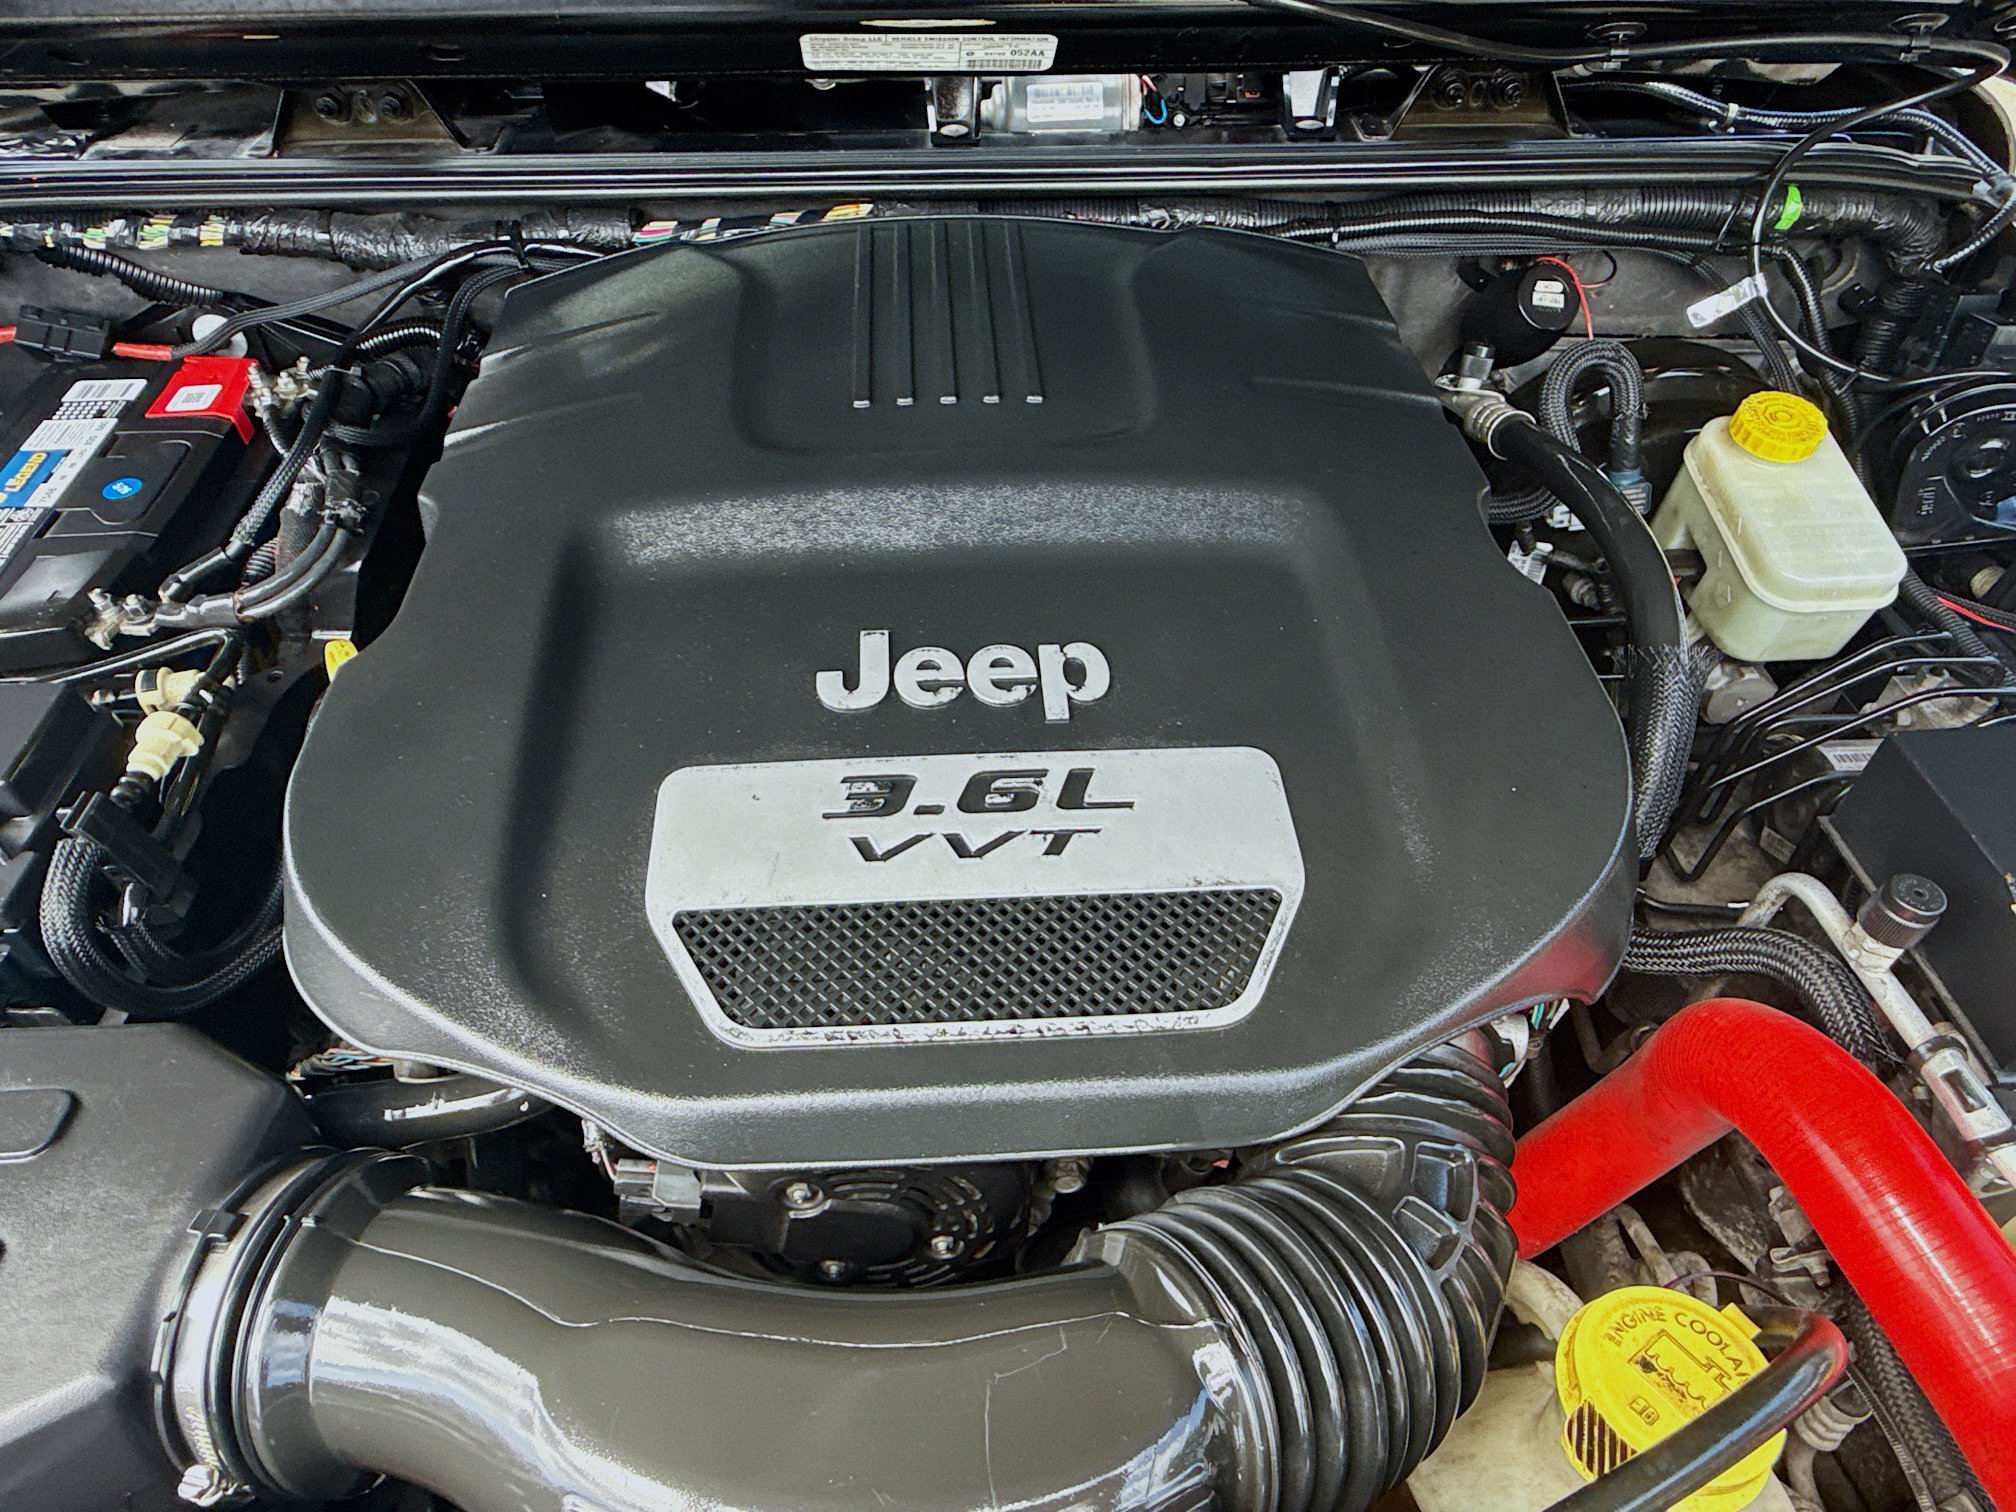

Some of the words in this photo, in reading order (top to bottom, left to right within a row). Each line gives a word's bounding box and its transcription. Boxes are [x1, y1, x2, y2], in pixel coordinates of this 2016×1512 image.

[1010, 49, 1046, 57] 052AA
[815, 629, 1111, 723] Jeep
[822, 767, 1136, 819] 3.6L
[849, 825, 1103, 862] VVT
[1604, 1305, 1668, 1348] ENGINE
